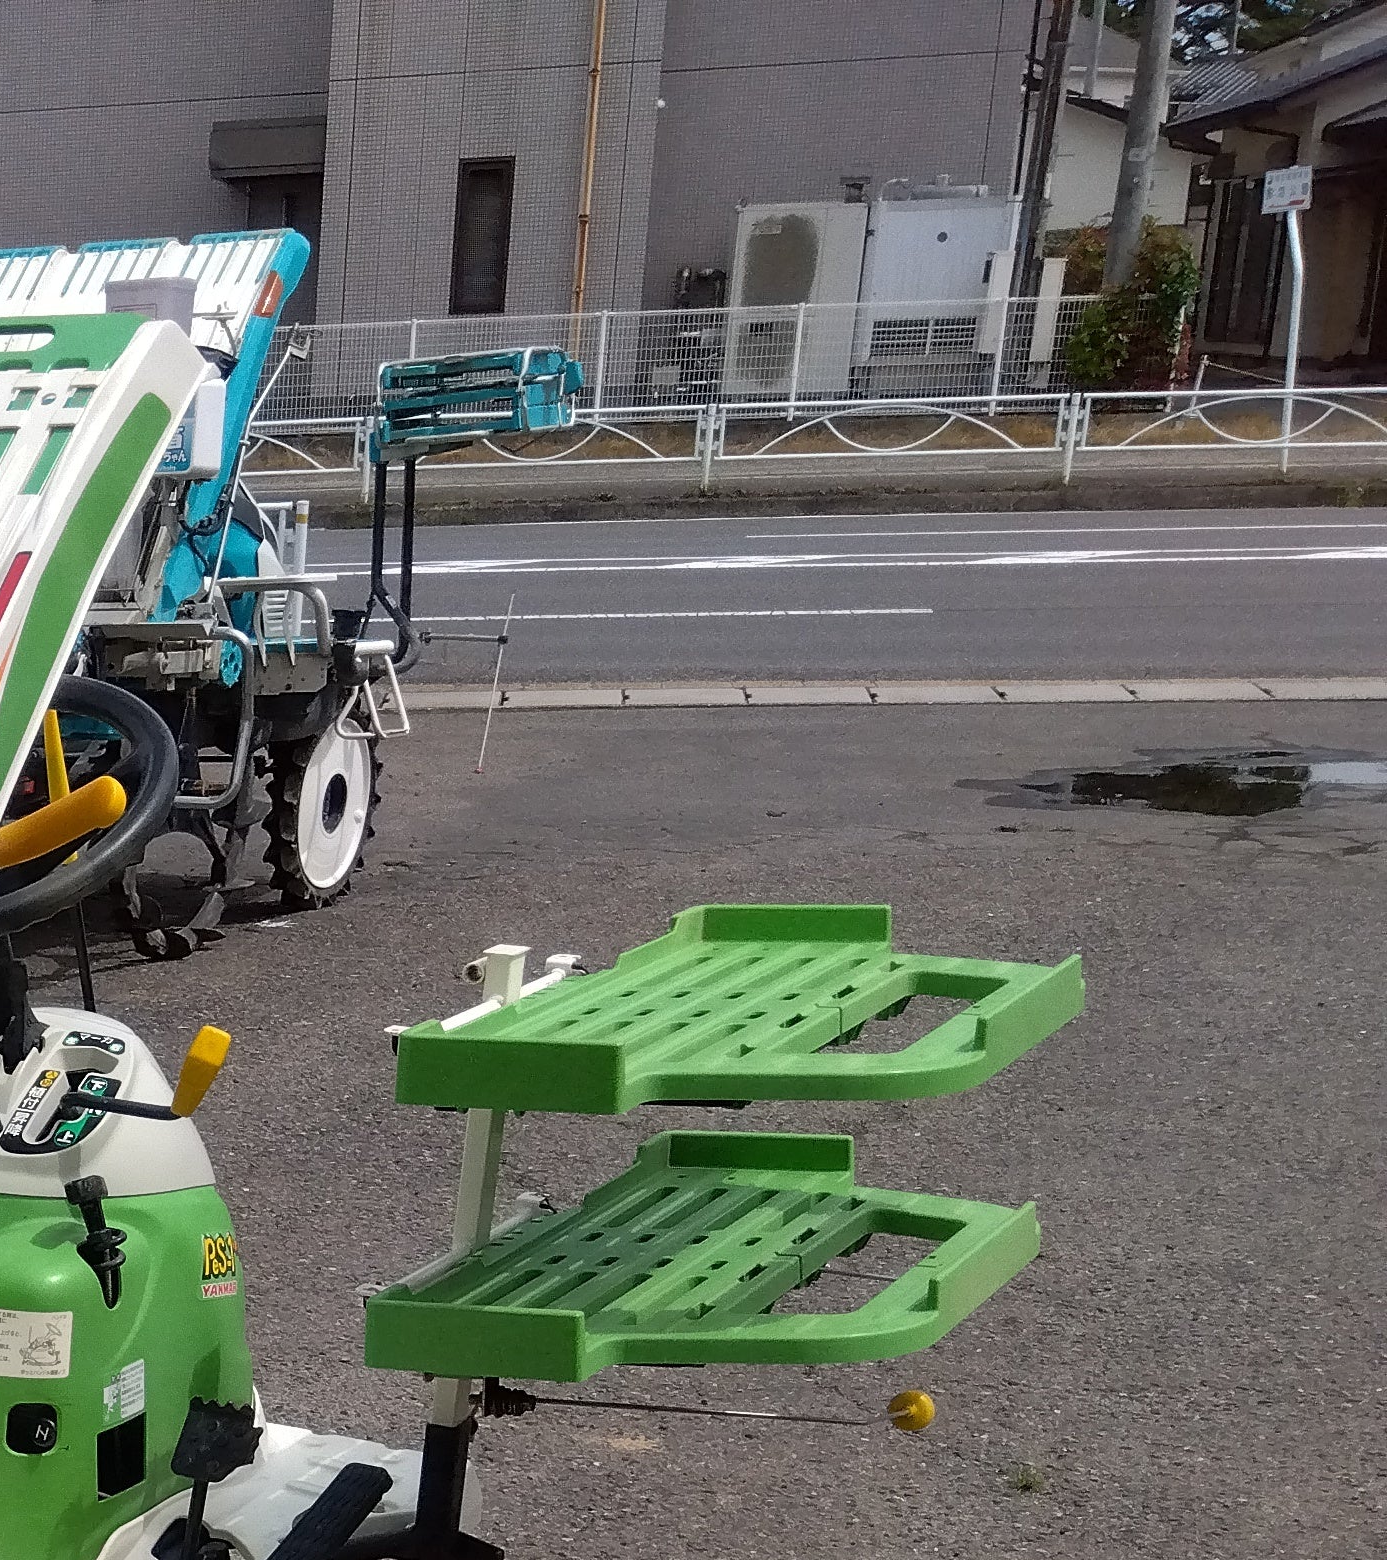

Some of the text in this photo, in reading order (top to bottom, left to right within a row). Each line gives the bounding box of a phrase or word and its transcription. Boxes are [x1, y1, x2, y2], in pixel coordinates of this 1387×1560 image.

[79, 1032, 115, 1045] マーカ
[90, 1079, 106, 1091] 下
[22, 1086, 47, 1109] 植付
[4, 1111, 30, 1136] 昇降
[56, 1131, 74, 1144] 上
